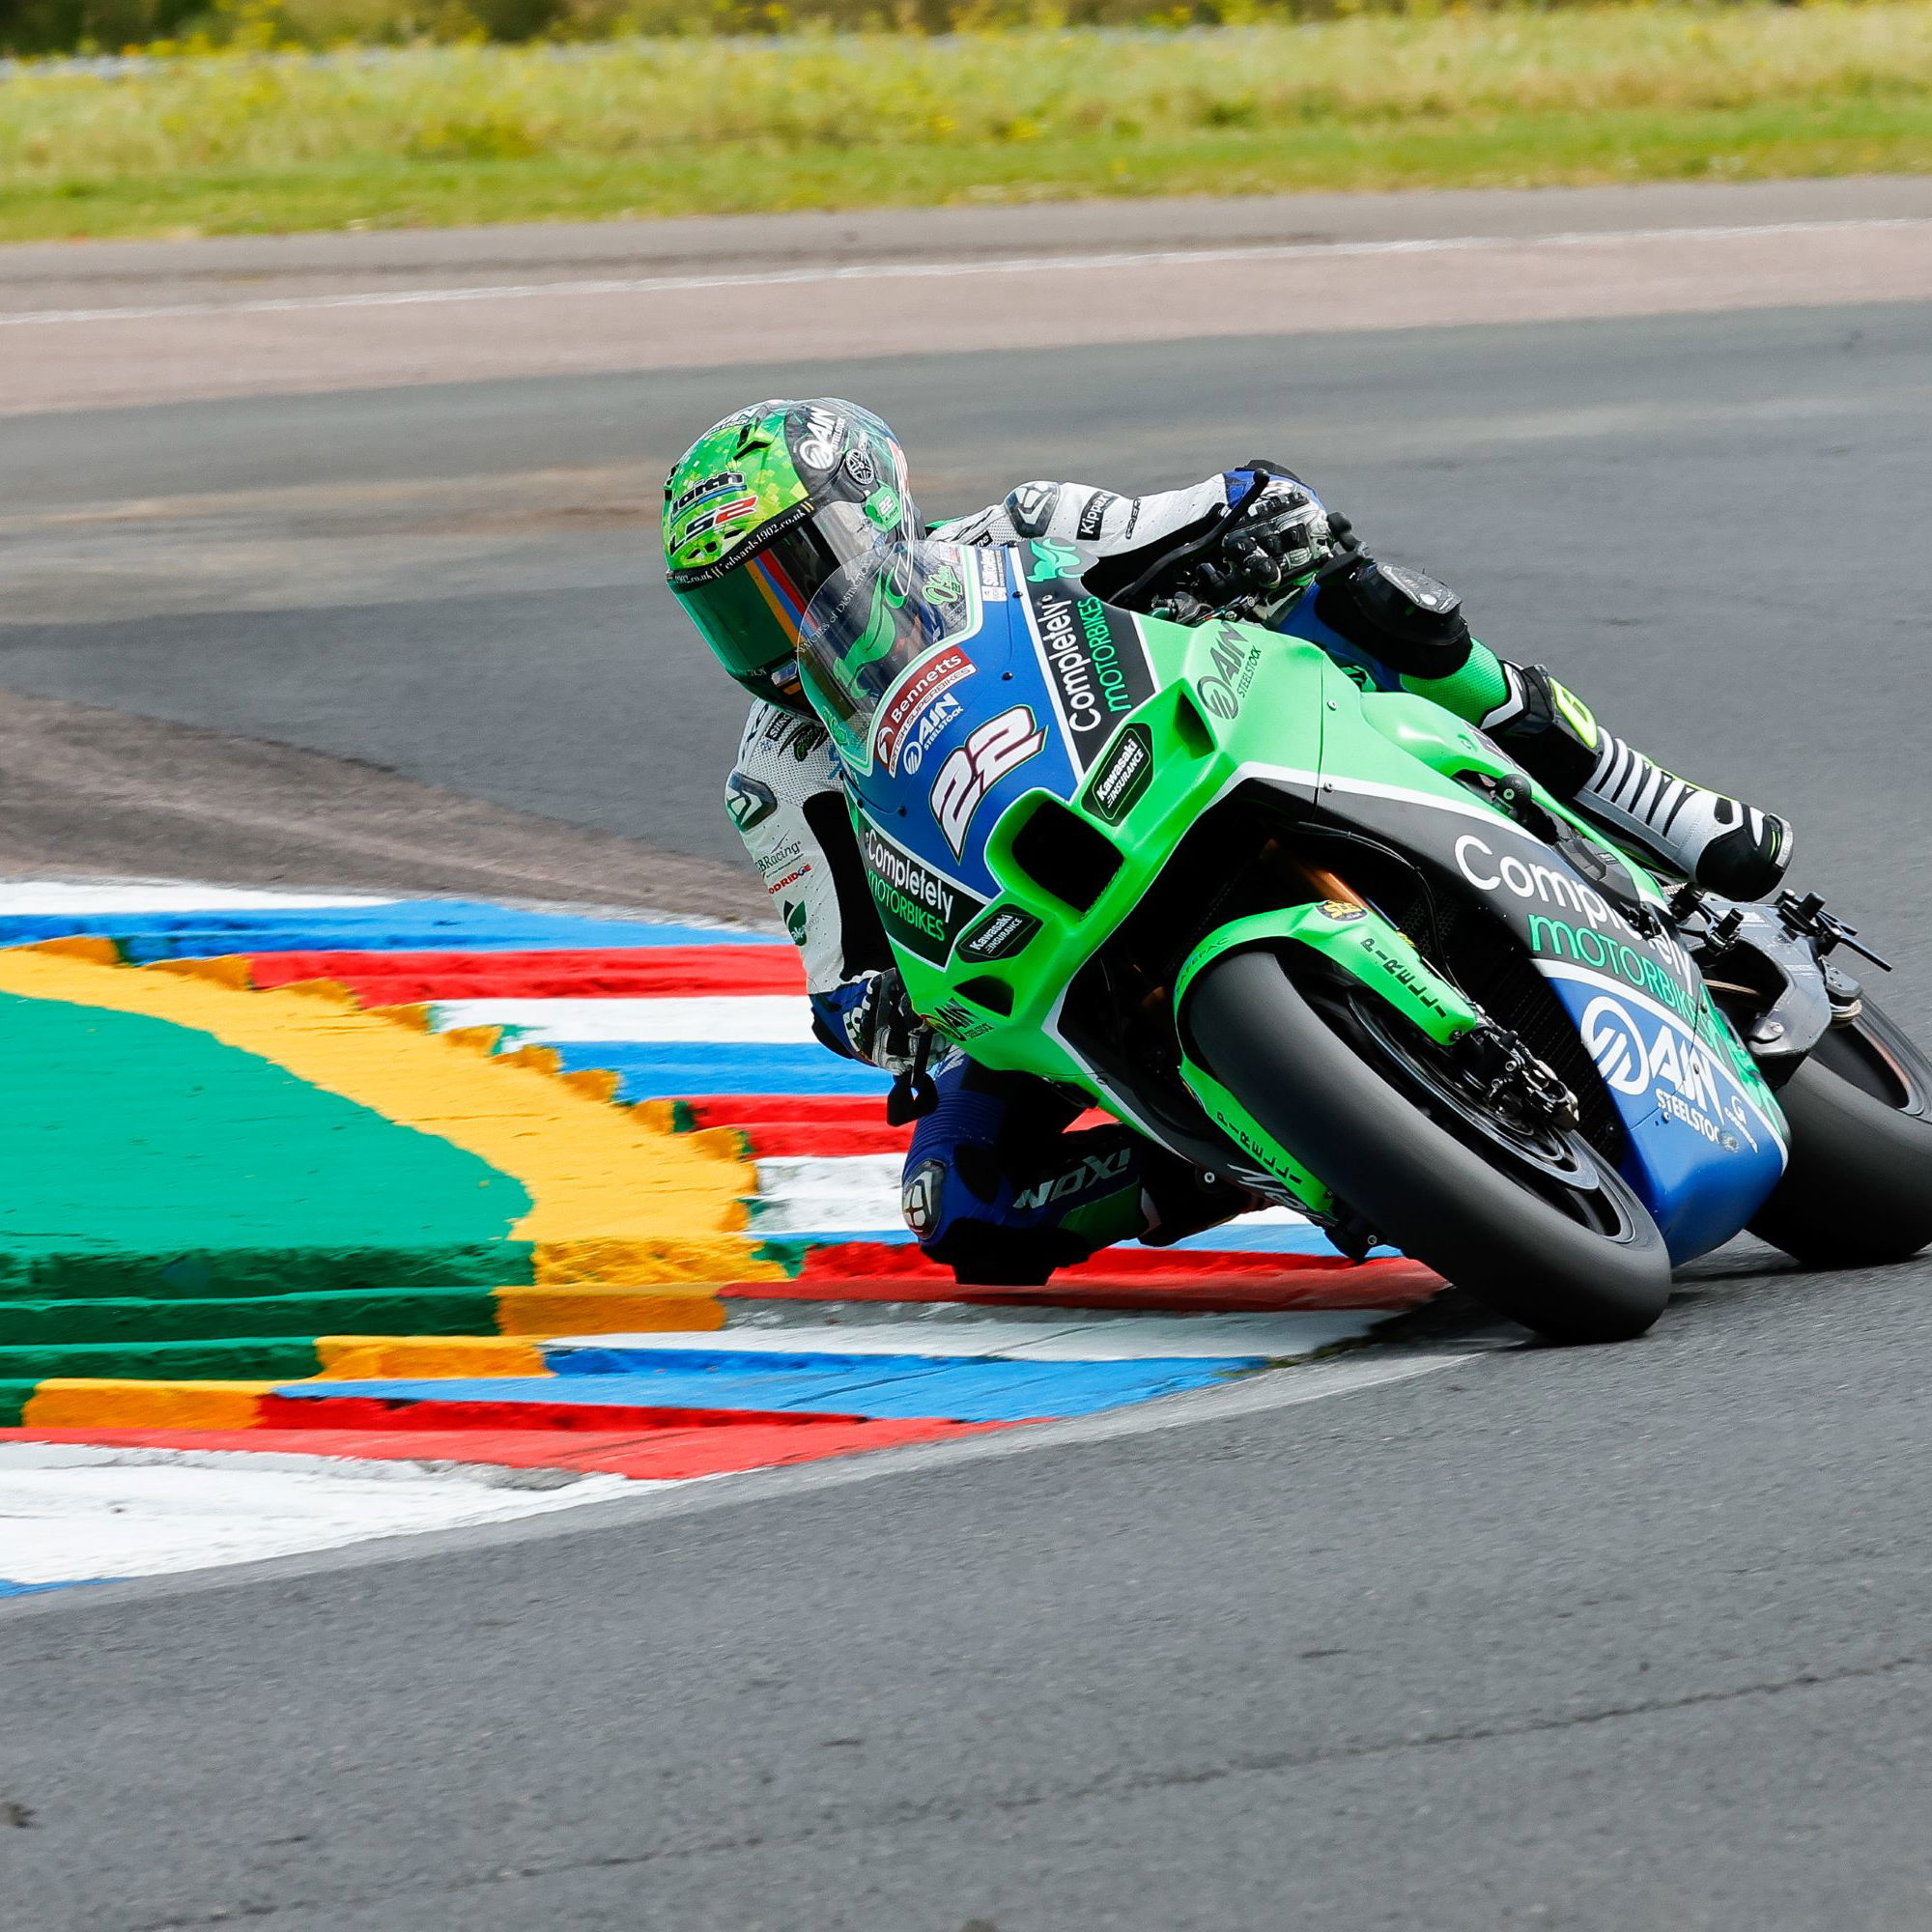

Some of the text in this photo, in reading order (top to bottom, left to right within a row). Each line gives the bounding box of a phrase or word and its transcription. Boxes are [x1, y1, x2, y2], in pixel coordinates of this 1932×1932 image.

[669, 496, 757, 556] LS2
[1080, 493, 1112, 534] Kippax
[891, 655, 962, 724] Bennetts
[907, 668, 971, 724] SUPERBIKES
[1038, 598, 1101, 732] Completely
[1237, 645, 1262, 698] STEELSTOCK
[923, 706, 964, 751] STEELSTOCK
[930, 705, 1047, 864] 22
[1096, 738, 1137, 800] Kawasaki
[868, 833, 953, 923] Completely
[970, 914, 1013, 951] Kawasaki
[1360, 938, 1447, 1018] PIRELLI
[1217, 1112, 1302, 1184] PIRELLI
